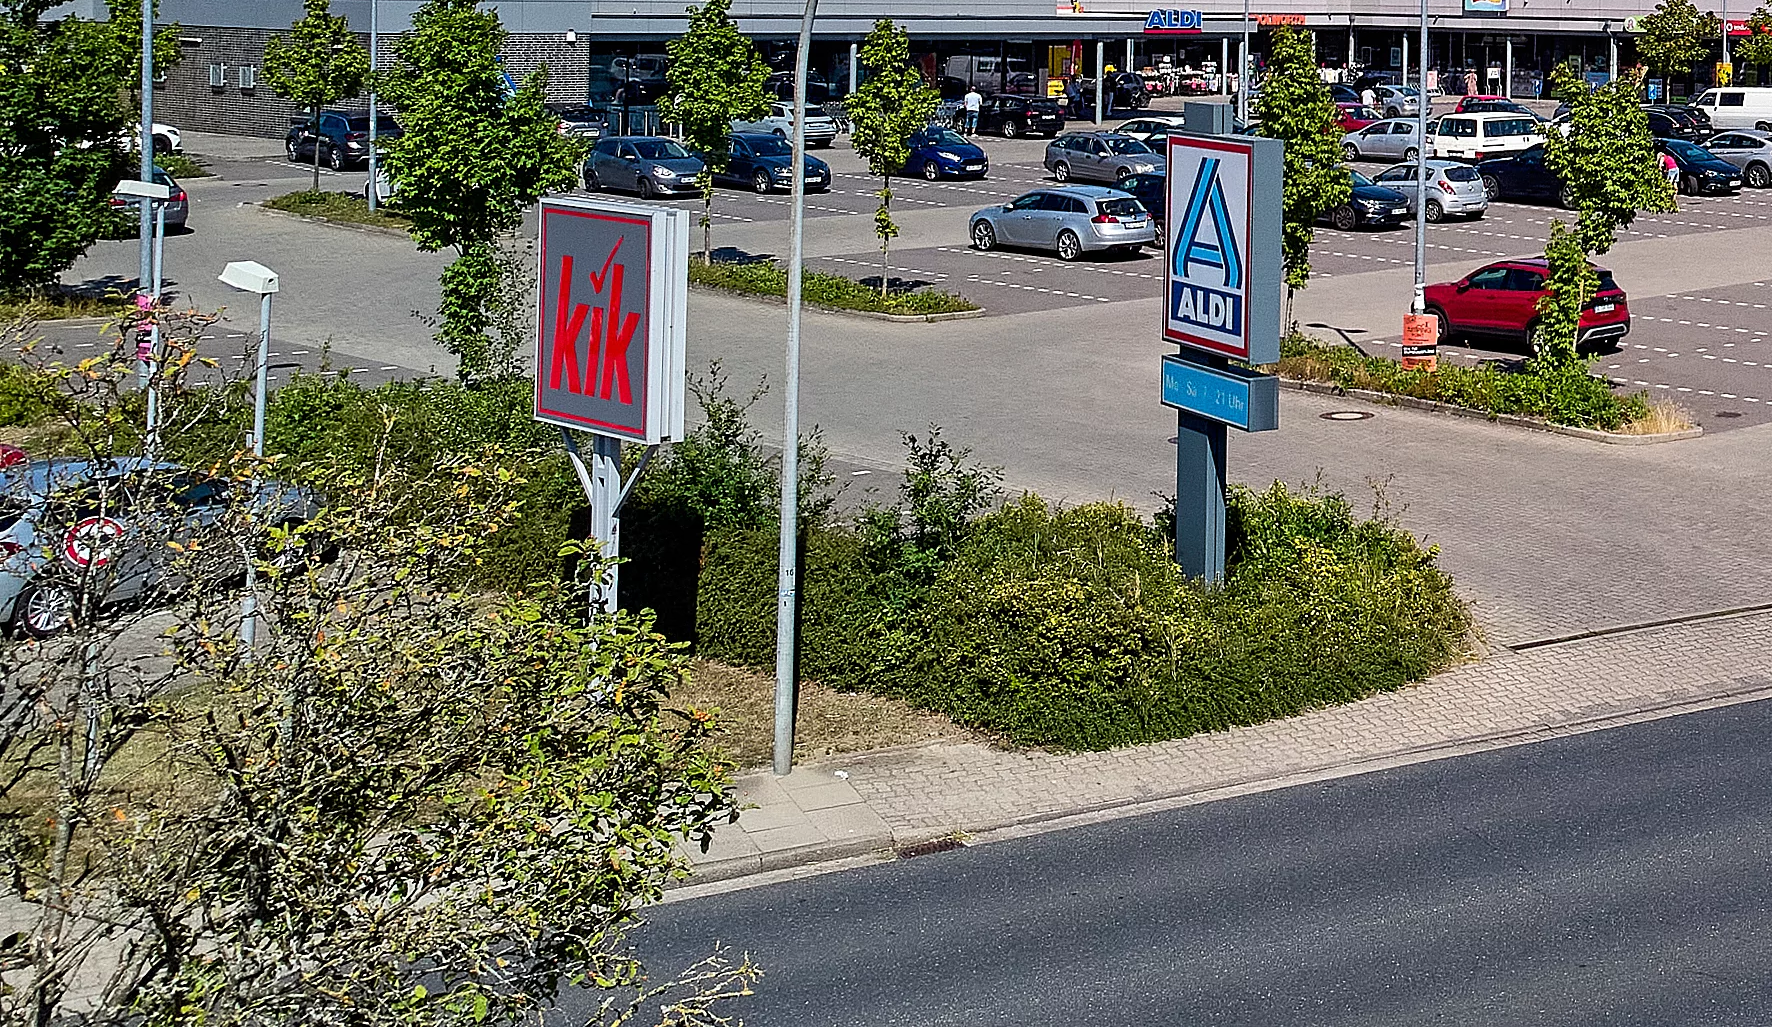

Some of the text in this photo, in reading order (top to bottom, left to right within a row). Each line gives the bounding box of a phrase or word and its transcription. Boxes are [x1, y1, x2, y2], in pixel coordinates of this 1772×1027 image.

[1145, 9, 1203, 29] ALDI
[549, 235, 641, 405] kik
[1177, 286, 1234, 330] ALDI
[1228, 393, 1244, 410] Uhr
